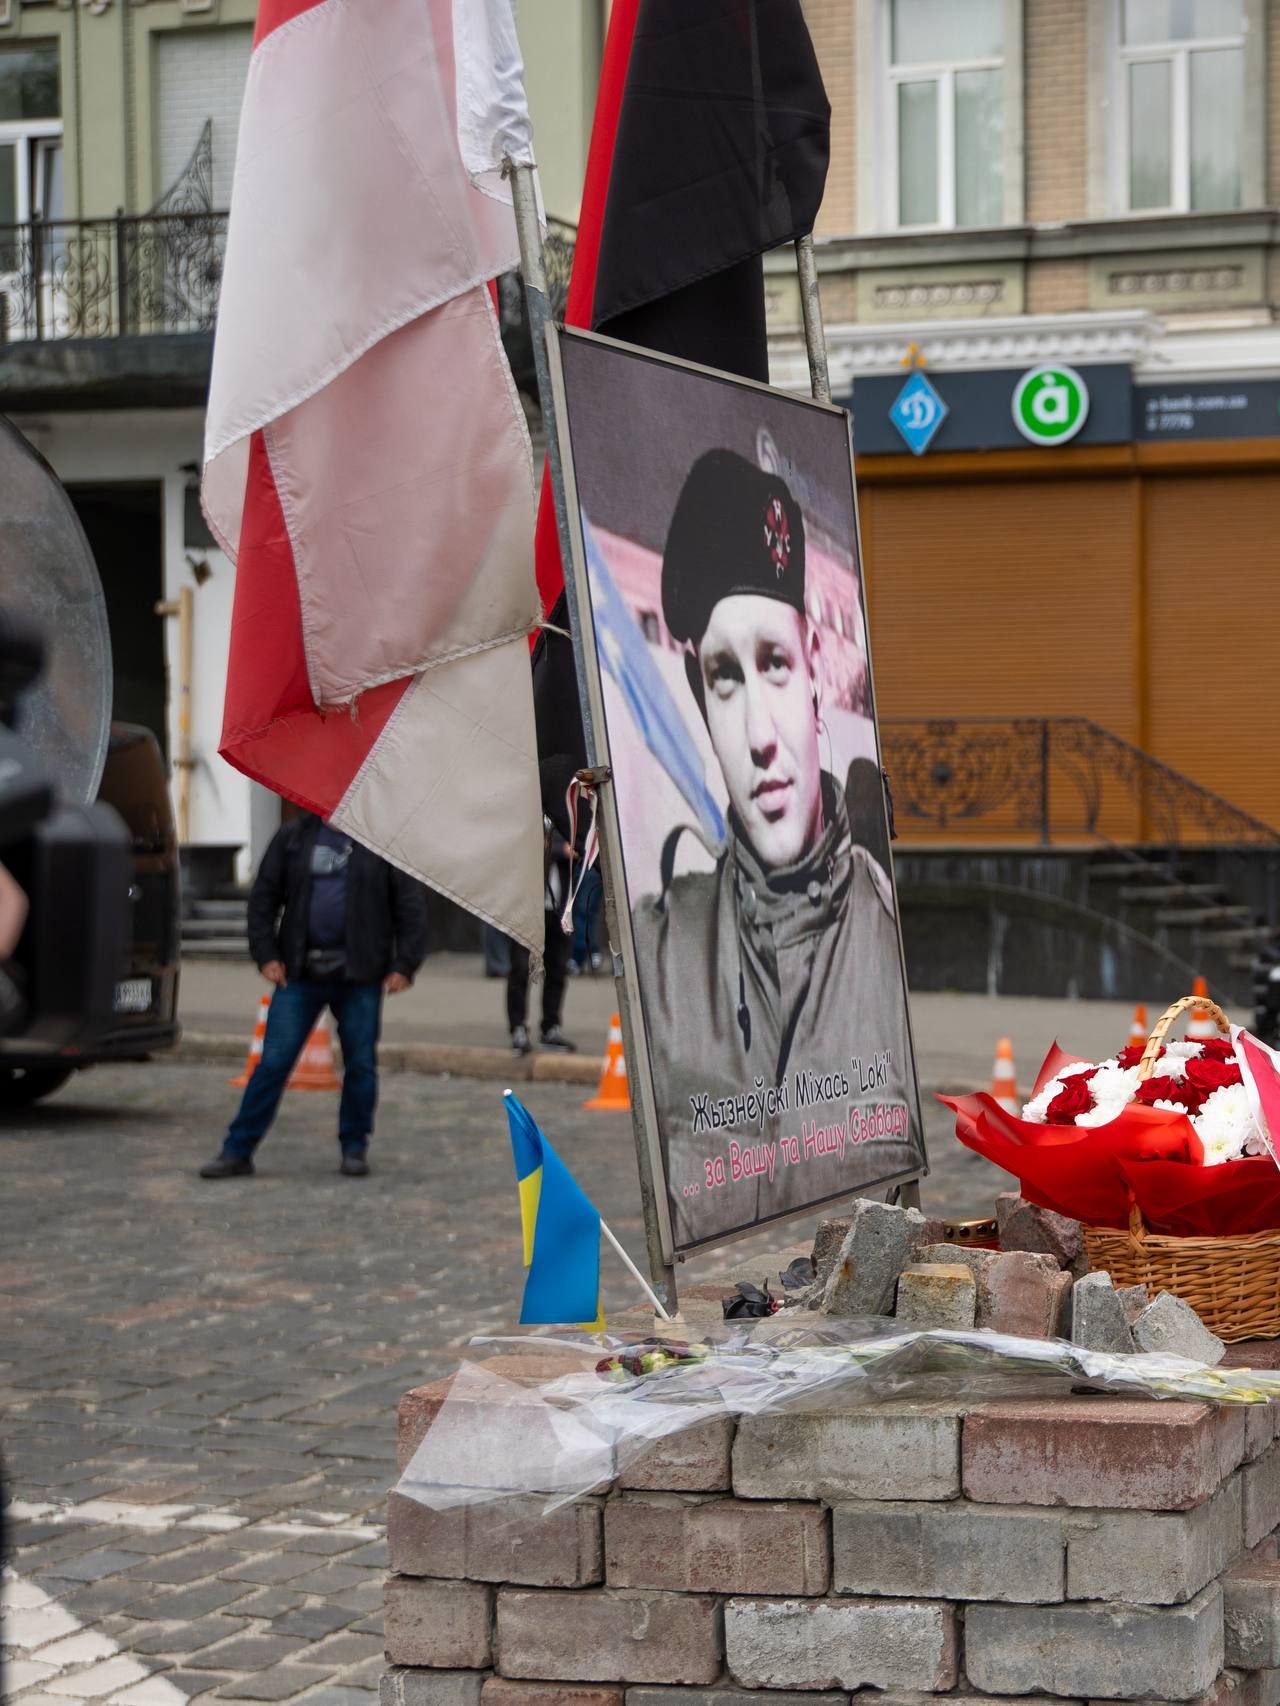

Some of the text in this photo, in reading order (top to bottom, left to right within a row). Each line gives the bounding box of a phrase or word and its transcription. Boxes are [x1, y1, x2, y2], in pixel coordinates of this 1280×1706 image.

[690, 1076, 790, 1133] Жызнеўскі
[795, 1070, 850, 1109] Міхась
[730, 1142, 776, 1182] Вашу
[780, 1137, 800, 1166] та
[802, 1120, 846, 1160] Нашу
[850, 1103, 909, 1144] Свободу
